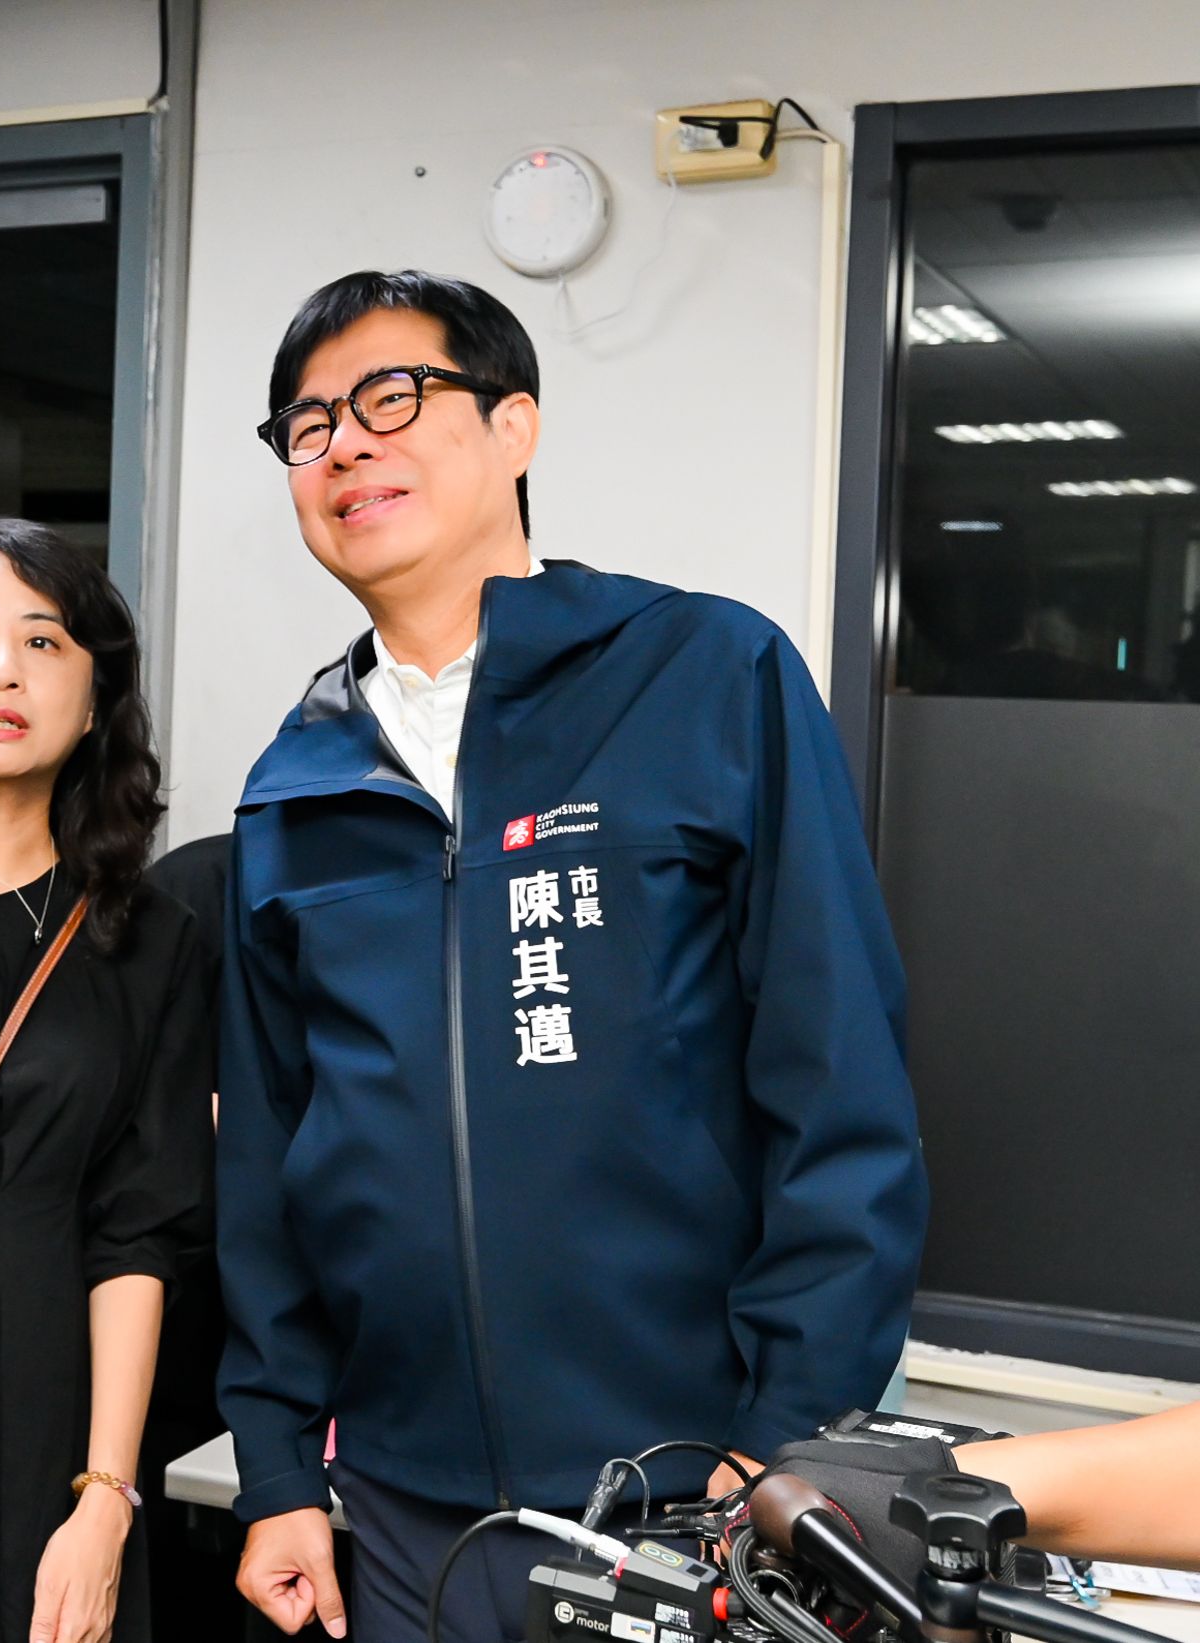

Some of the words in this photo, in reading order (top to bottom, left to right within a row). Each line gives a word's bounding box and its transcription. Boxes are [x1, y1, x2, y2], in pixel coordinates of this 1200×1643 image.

[536, 802, 599, 823] KAOHSIUNG
[535, 819, 555, 831] CITY
[535, 822, 599, 840] GOVERNMENT
[568, 865, 604, 929] 市長
[509, 869, 578, 1067] 陳其邁
[576, 1615, 610, 1632] motor
